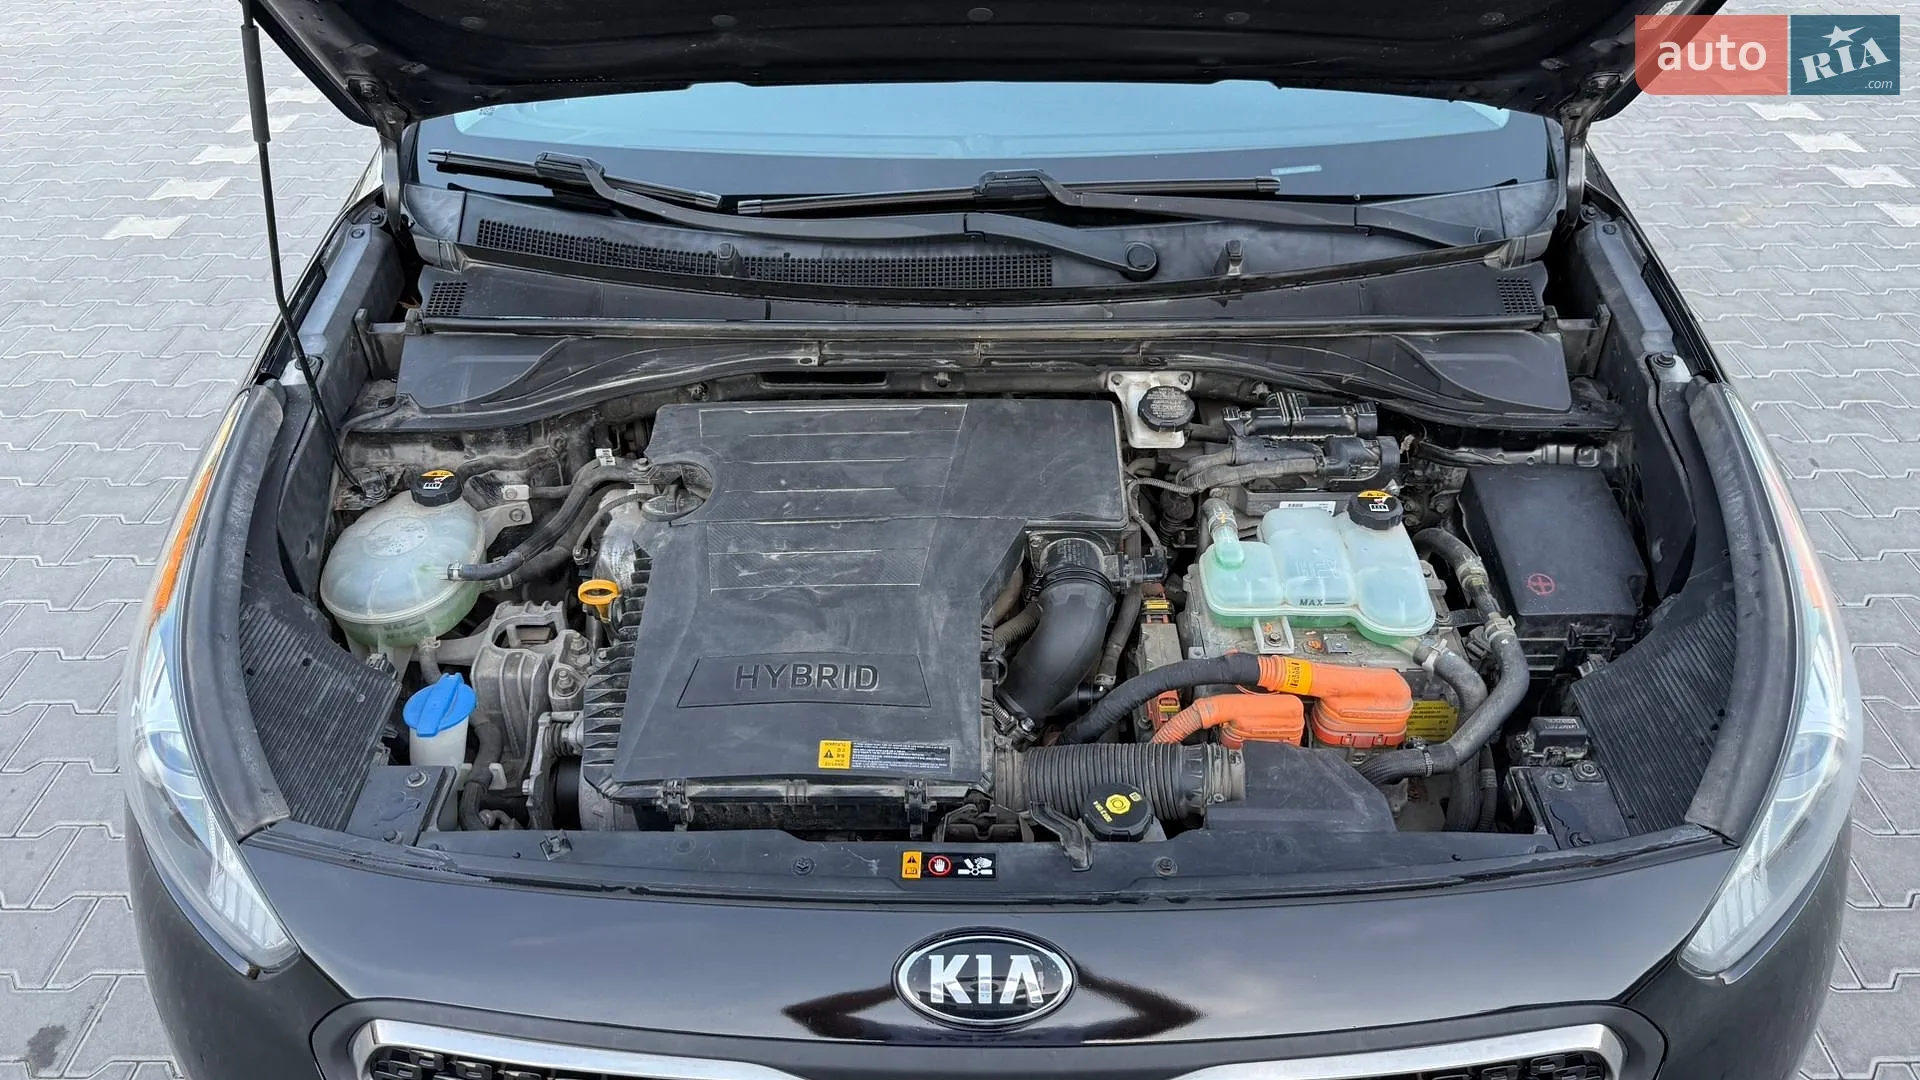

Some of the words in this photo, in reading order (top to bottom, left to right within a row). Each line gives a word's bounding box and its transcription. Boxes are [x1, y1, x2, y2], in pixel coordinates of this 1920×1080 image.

[1299, 599, 1324, 607] MAX
[735, 663, 879, 691] HYBRID
[928, 954, 1045, 1004] KIA
